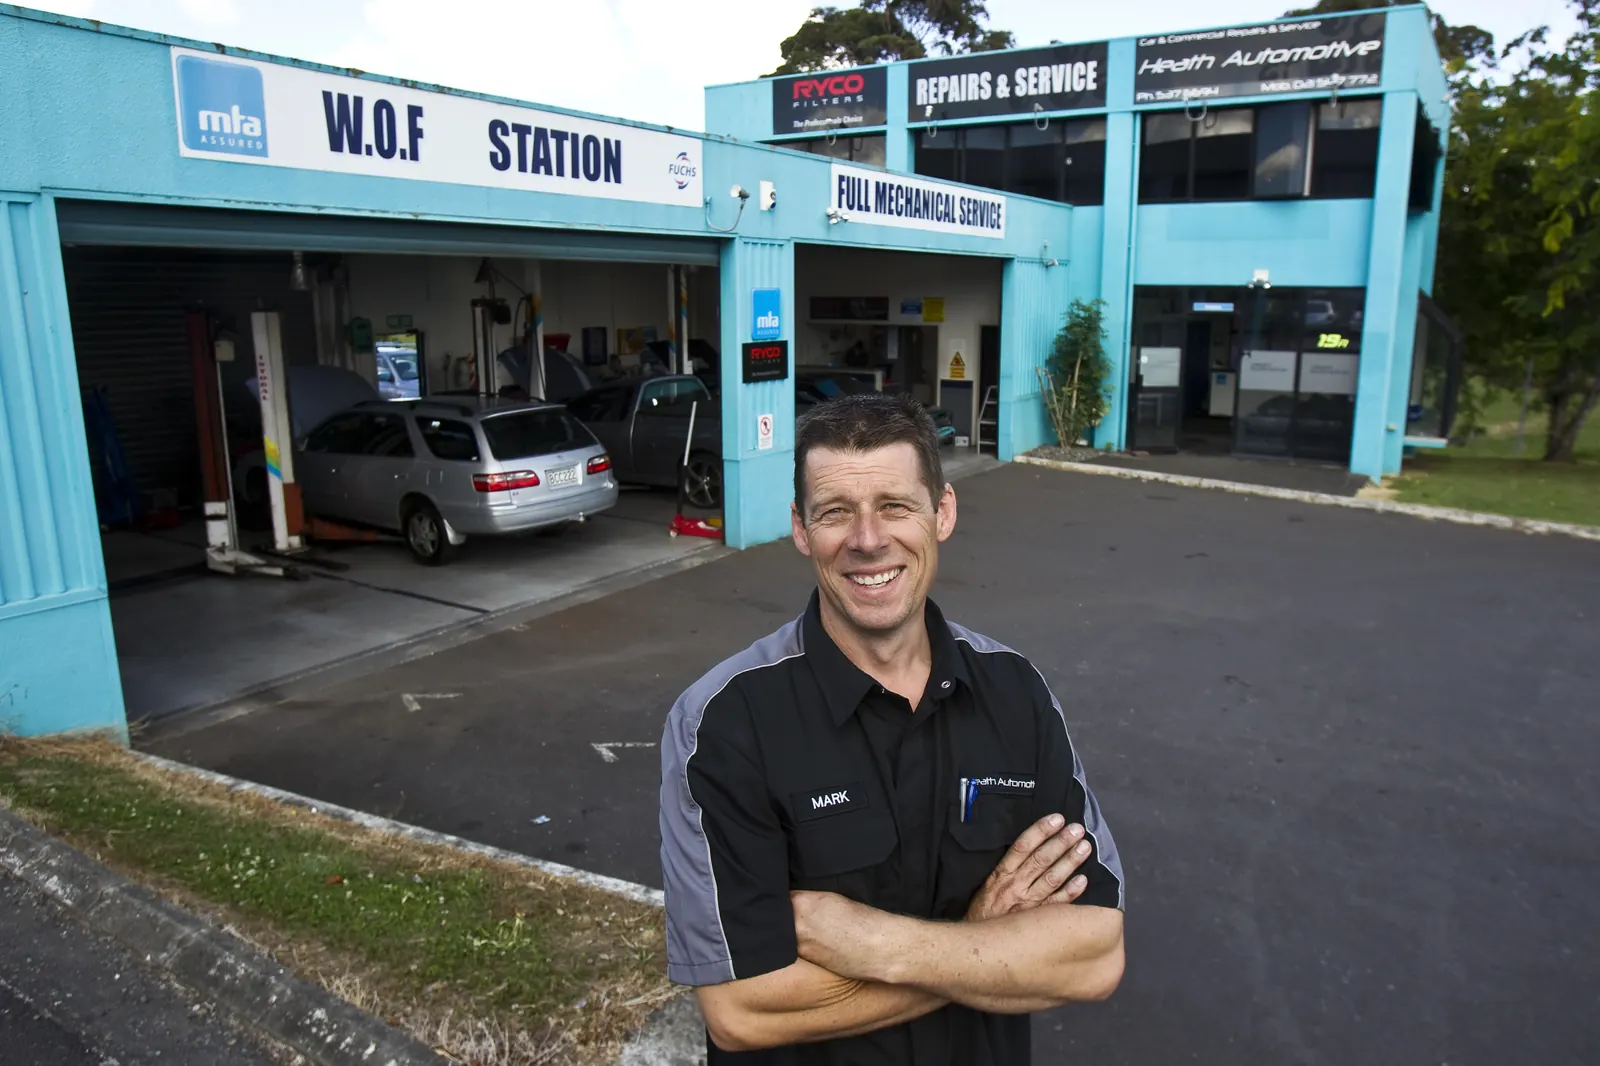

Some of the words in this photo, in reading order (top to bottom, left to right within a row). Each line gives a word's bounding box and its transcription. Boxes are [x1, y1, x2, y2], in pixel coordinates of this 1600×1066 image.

[1167, 30, 1225, 43] Commercial
[1226, 25, 1267, 37] Repairs
[1278, 21, 1321, 32] Service
[1137, 54, 1216, 75] Heath
[1221, 40, 1381, 68] Automotive
[793, 74, 865, 99] RYCO
[916, 71, 992, 106] REPAIRS
[996, 74, 1010, 98] &
[1015, 61, 1098, 97] SERVICE
[793, 95, 863, 108] FILTERS
[199, 105, 262, 136] mta
[201, 135, 263, 150] ASSURED
[322, 90, 424, 161] W.O.F
[488, 119, 622, 184] STATION
[669, 163, 696, 177] FUCHS
[838, 175, 870, 213] FULL
[875, 181, 956, 224] MECHANICAL
[959, 196, 1001, 230] SERVICE
[757, 310, 779, 328] mta
[751, 346, 781, 359] RYCO
[811, 790, 850, 809] MARK
